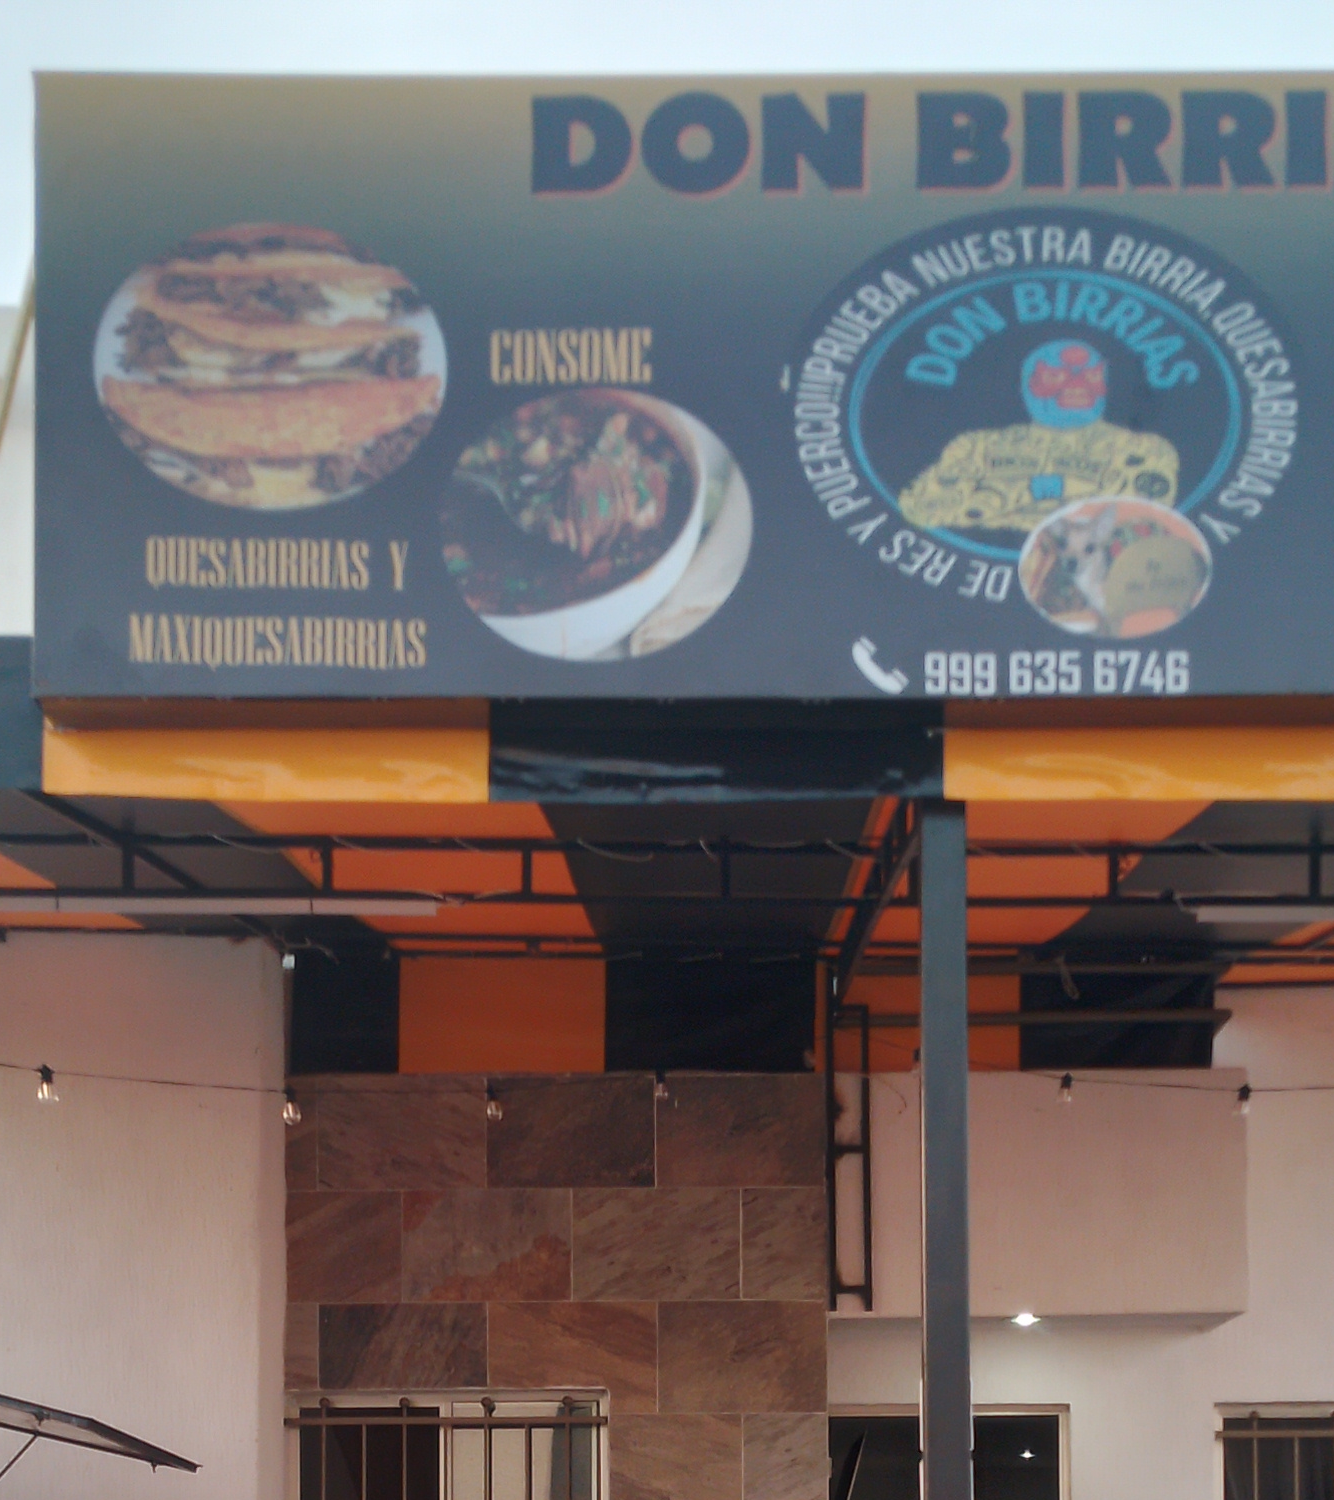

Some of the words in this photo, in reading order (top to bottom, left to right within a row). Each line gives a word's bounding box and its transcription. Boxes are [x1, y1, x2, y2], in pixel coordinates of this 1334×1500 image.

[531, 91, 869, 197] DON
[911, 225, 1092, 288] NUESTRA
[489, 326, 653, 385] CONSOME
[802, 269, 920, 383] PRUEBA
[905, 296, 1008, 388] DON
[1012, 280, 1200, 390] BIRRIAS
[1212, 302, 1299, 517] QUESABIRRIAS
[846, 512, 889, 545] Y
[878, 529, 958, 587] RES
[1199, 513, 1241, 545] Y
[144, 535, 370, 591] QUESABIRRIAS
[388, 539, 410, 592] Y
[958, 559, 1014, 602] DE
[129, 612, 428, 672] MAXIQUESABIRRIAS
[924, 650, 998, 696] 999
[1009, 649, 1083, 695] 635
[1093, 649, 1191, 695] 6746
